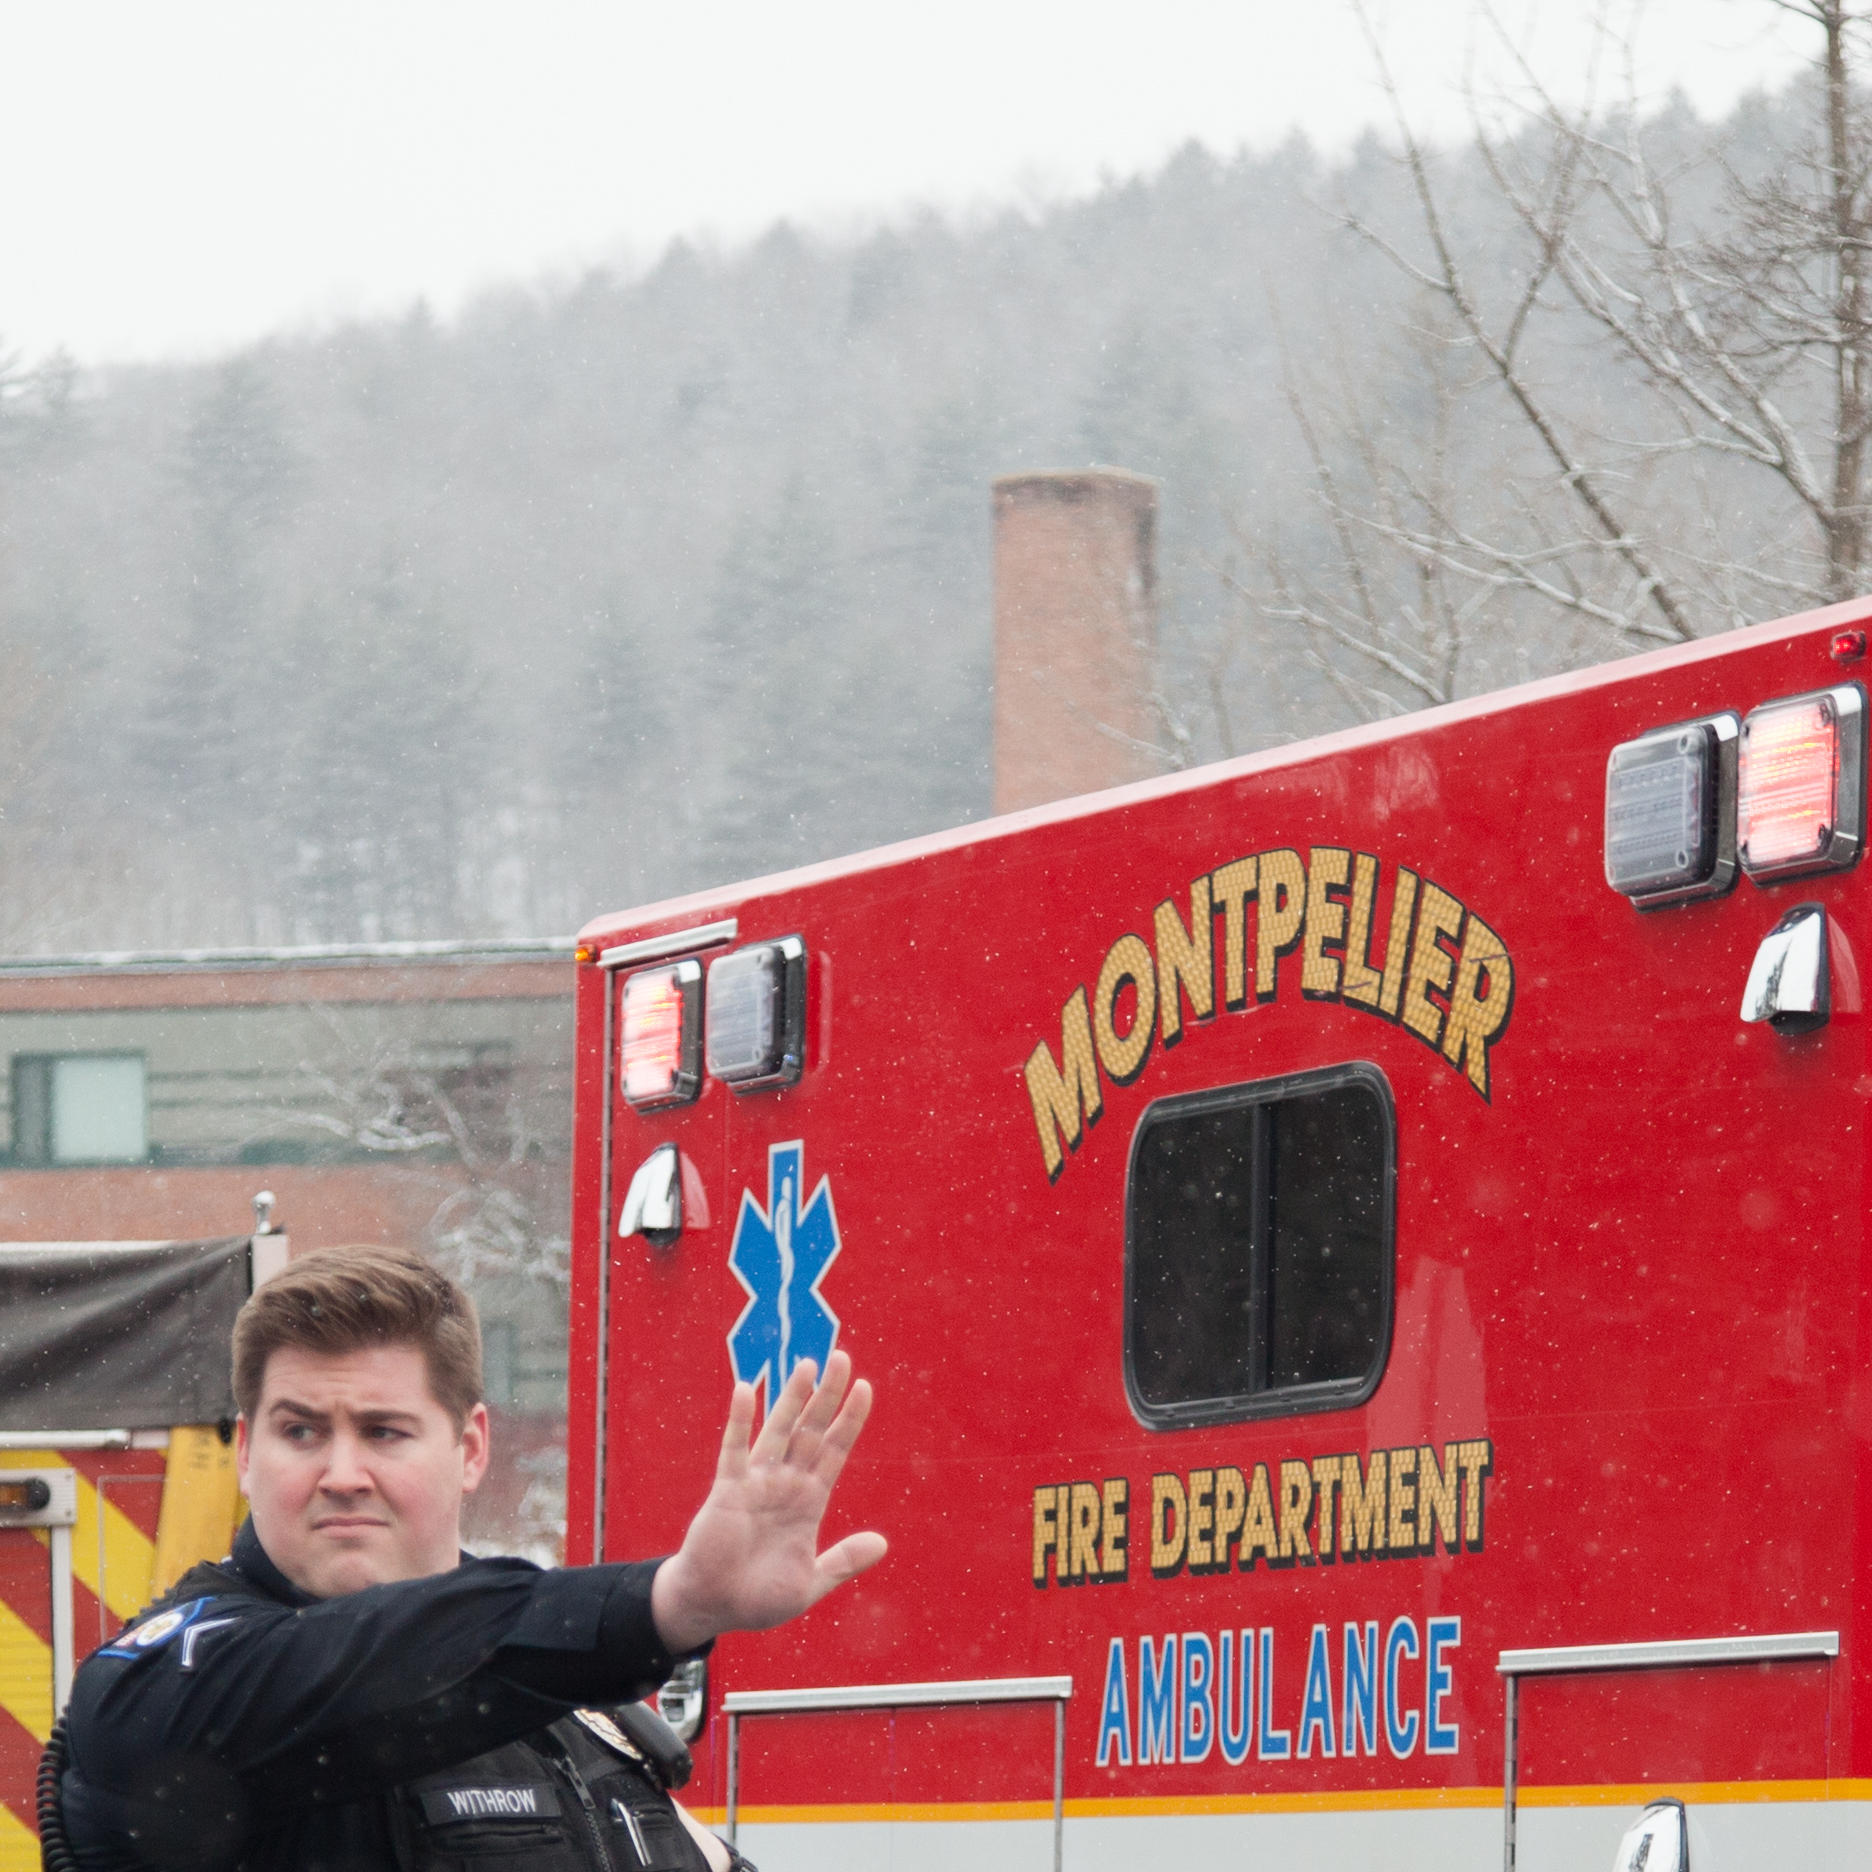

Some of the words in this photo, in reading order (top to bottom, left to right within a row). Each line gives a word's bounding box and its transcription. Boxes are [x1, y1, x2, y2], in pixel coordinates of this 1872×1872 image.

[1024, 845, 1516, 1187] MONTPELIER
[1032, 1477, 1129, 1588] FIRE
[1150, 1438, 1494, 1579] DEPARTMENT
[1095, 1615, 1462, 1767] AMBULANCE
[447, 1788, 536, 1815] WITHROW
